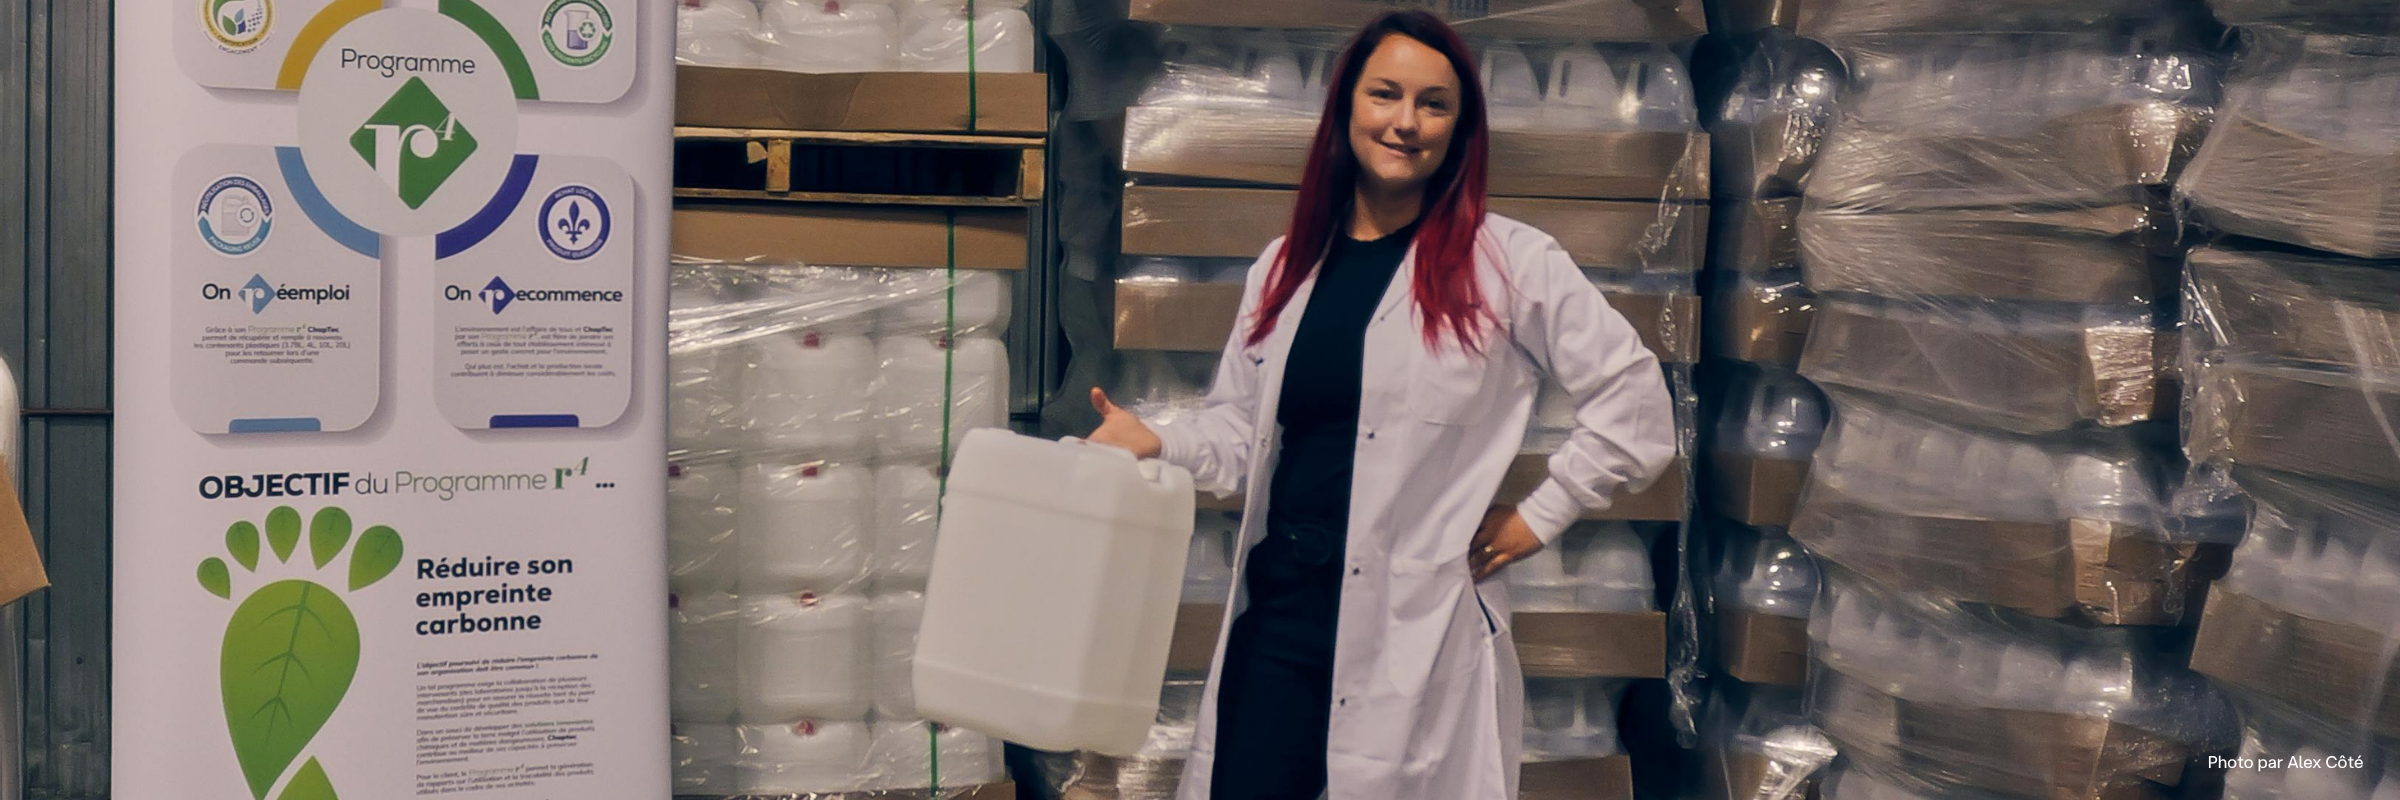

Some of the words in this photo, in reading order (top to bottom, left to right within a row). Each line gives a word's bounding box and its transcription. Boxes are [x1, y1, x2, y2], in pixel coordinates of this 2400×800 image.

[341, 48, 476, 78] Programme
[202, 283, 231, 300] On
[444, 284, 471, 301] On
[199, 472, 350, 499] OBJECTIF
[355, 472, 388, 494] du
[395, 470, 547, 501] Programme
[416, 555, 521, 580] Réduire
[527, 558, 573, 575] son
[415, 582, 553, 611] empreinte
[415, 612, 542, 636] carbonne
